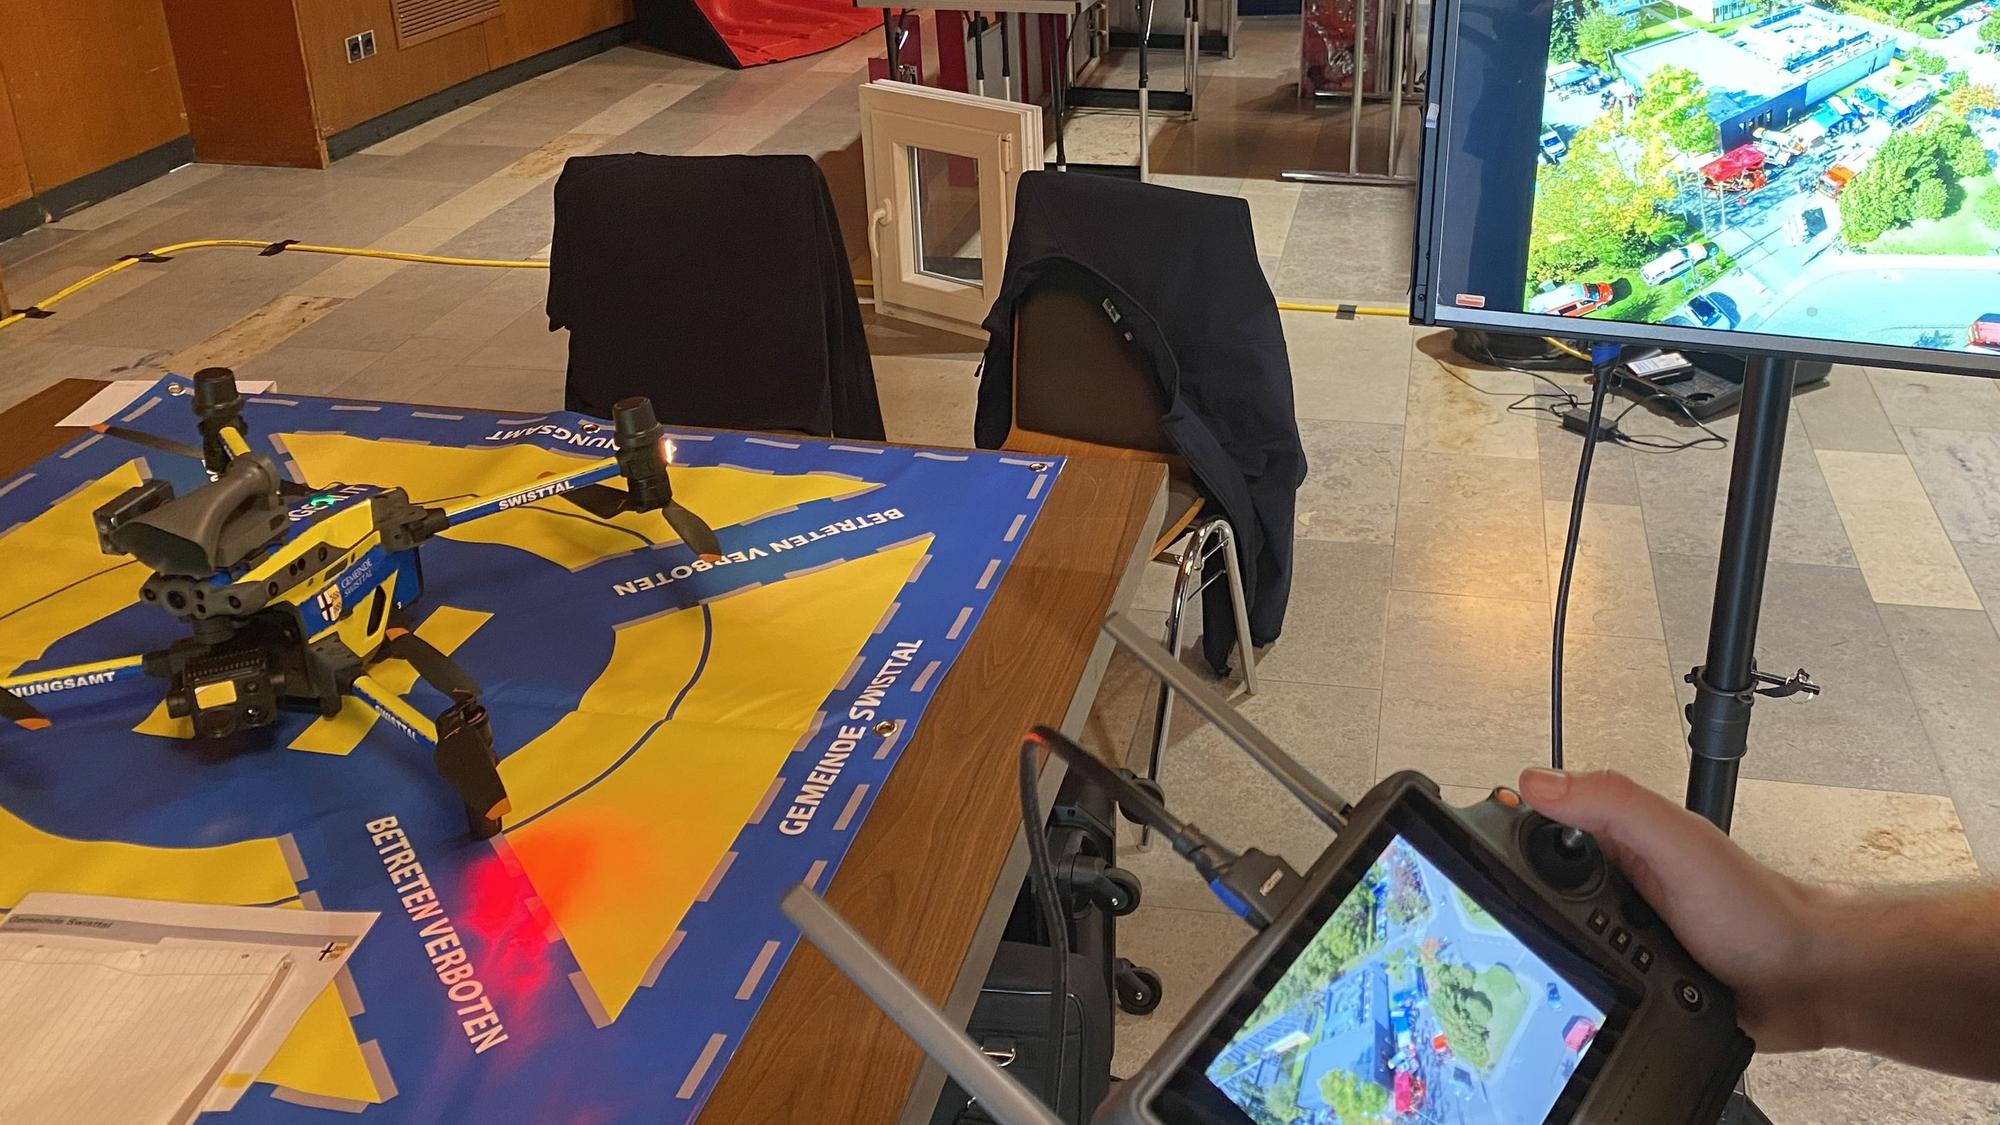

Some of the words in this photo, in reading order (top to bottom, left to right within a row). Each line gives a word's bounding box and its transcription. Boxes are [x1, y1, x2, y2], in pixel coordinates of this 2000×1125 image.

[485, 424, 621, 451] NUNGSAMT
[498, 480, 574, 510] SWISTTAL
[768, 508, 905, 553] BETRETEN
[7, 671, 116, 699] NUNGSAMT
[778, 724, 867, 836] GEMEINDE
[848, 639, 924, 721] SWISTTAL
[365, 815, 444, 922] BETRETEN
[418, 917, 509, 1055] VERBOTEN
